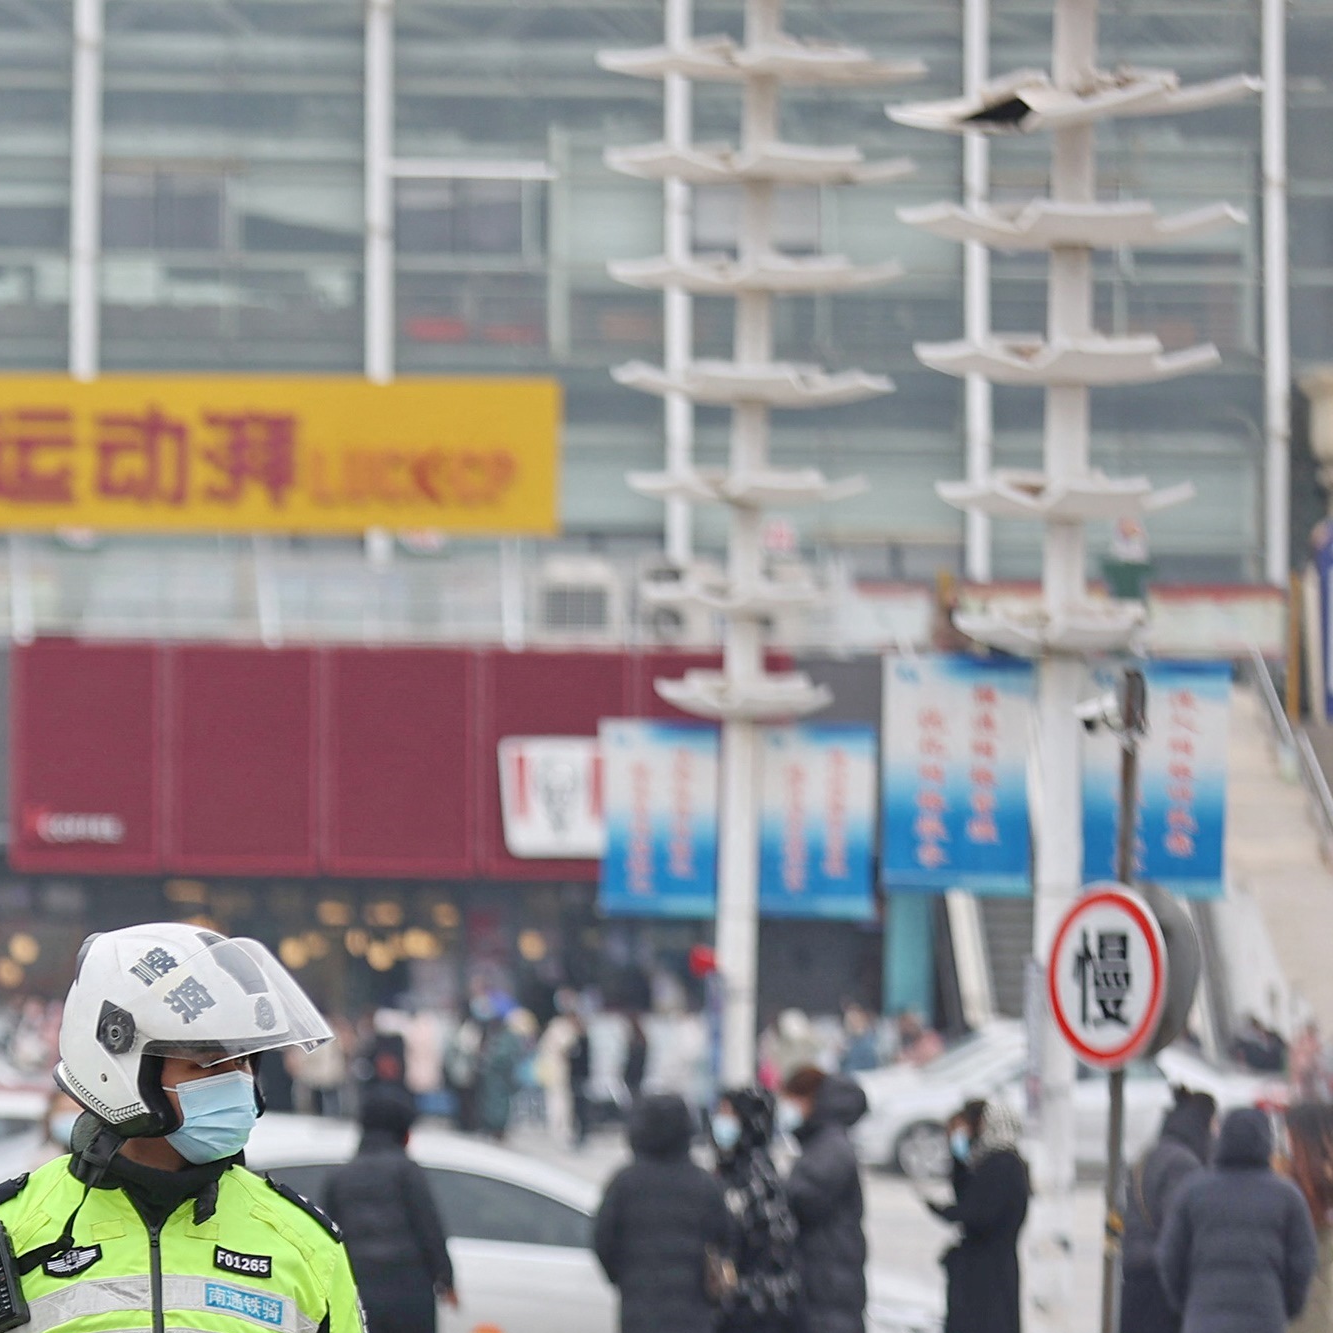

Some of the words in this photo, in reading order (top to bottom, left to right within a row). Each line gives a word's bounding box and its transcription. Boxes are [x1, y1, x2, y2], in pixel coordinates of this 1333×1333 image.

[1073, 928, 1132, 1028] 慢
[216, 1250, 269, 1273] F01265
[207, 1285, 280, 1322] 南通铁骑
